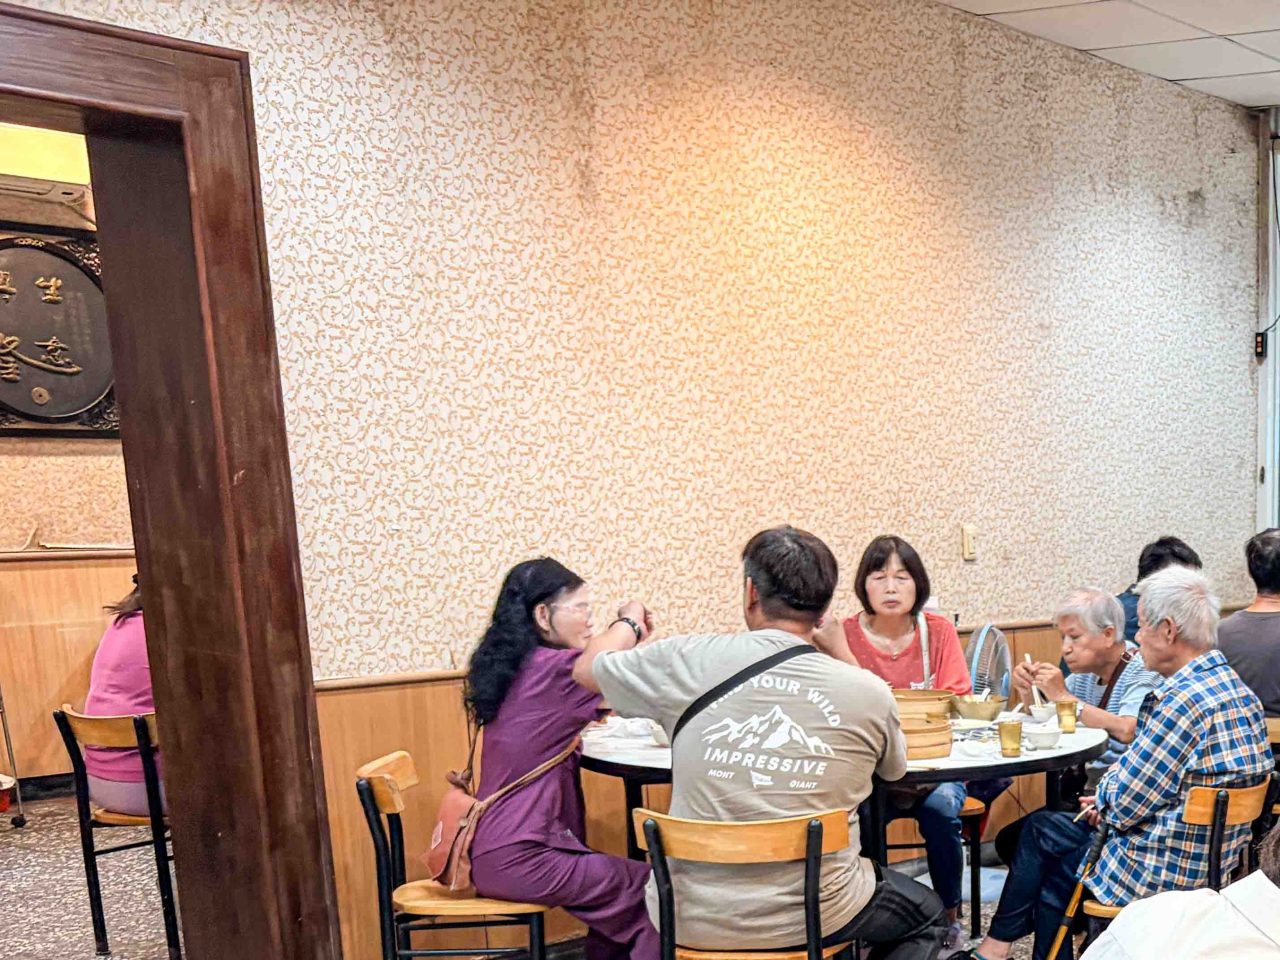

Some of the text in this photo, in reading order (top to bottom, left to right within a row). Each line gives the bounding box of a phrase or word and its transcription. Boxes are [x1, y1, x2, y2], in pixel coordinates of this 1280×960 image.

[749, 675, 801, 696] YOUR
[806, 687, 841, 727] WILD
[703, 747, 829, 776] IMPRESSIVE
[707, 768, 736, 780] MONT
